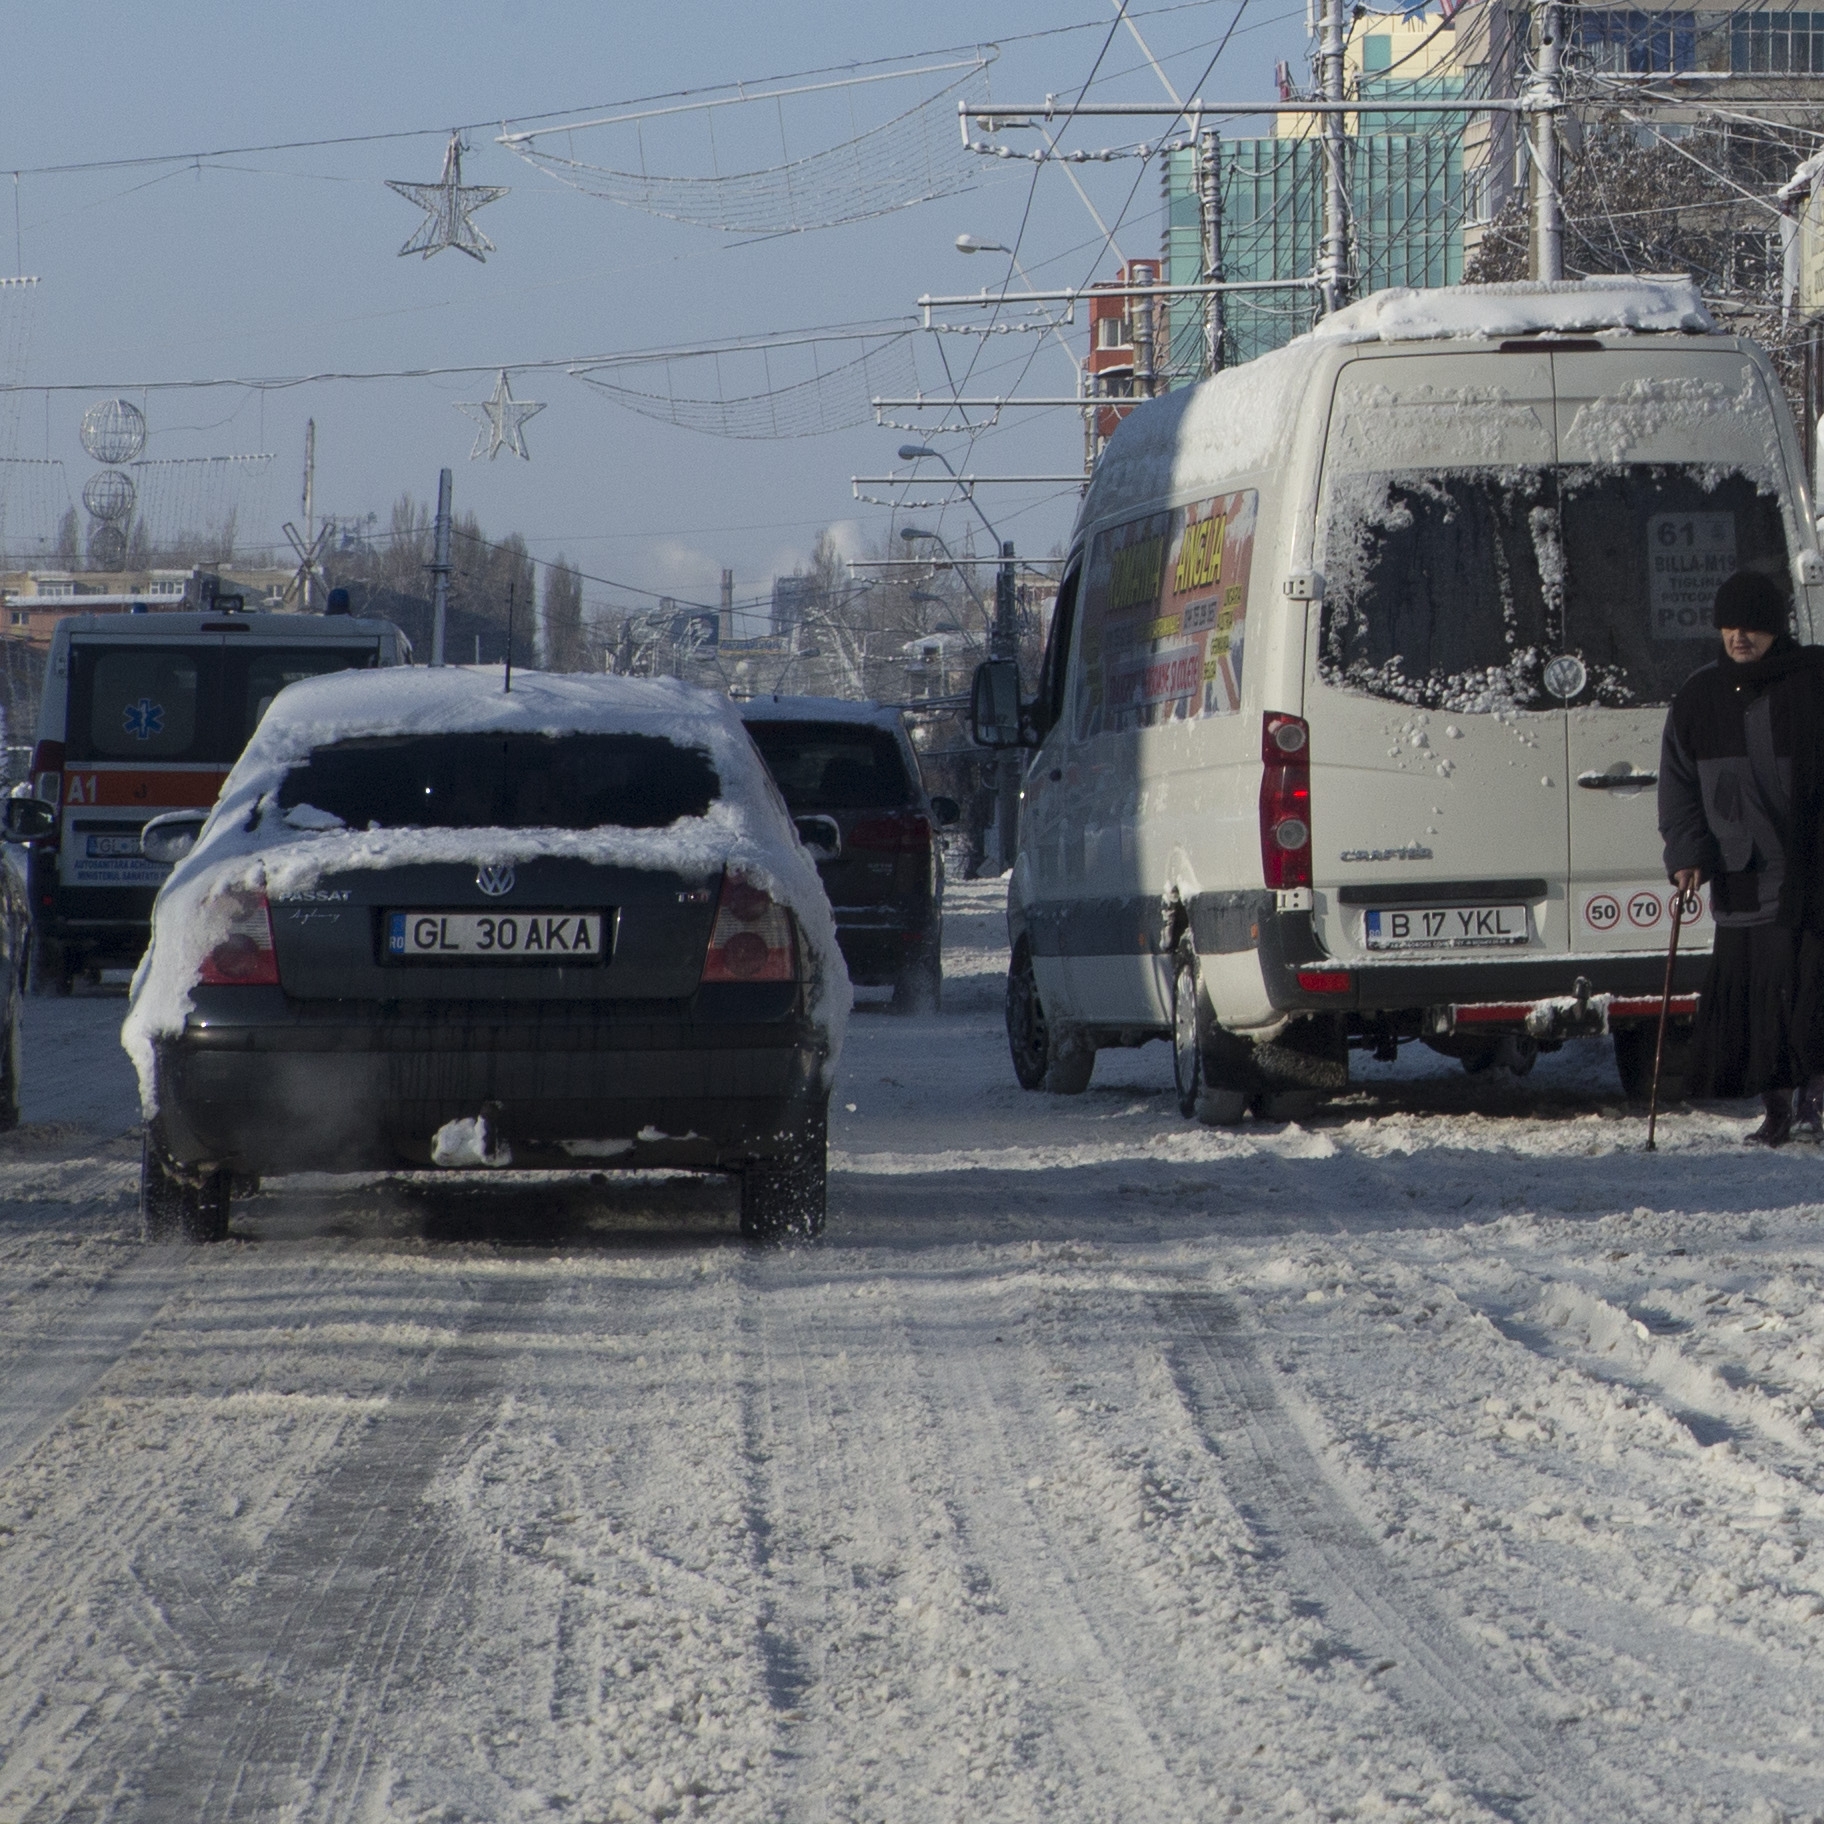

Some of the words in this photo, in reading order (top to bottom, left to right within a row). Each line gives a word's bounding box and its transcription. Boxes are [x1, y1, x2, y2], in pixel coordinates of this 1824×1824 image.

[1658, 522, 1694, 546] 61
[1173, 512, 1227, 595] ANGLIA
[67, 775, 97, 803] A1
[1340, 847, 1434, 862] CRAFTER
[281, 890, 352, 902] PASSAT
[1391, 913, 1410, 938] B
[1422, 912, 1446, 937] 17
[1458, 910, 1511, 936] YKL
[1592, 905, 1616, 920] 50
[1633, 902, 1657, 917] 70
[389, 936, 405, 950] RO
[413, 918, 460, 950] GL
[476, 919, 517, 950] 30
[524, 919, 592, 950] AKA
